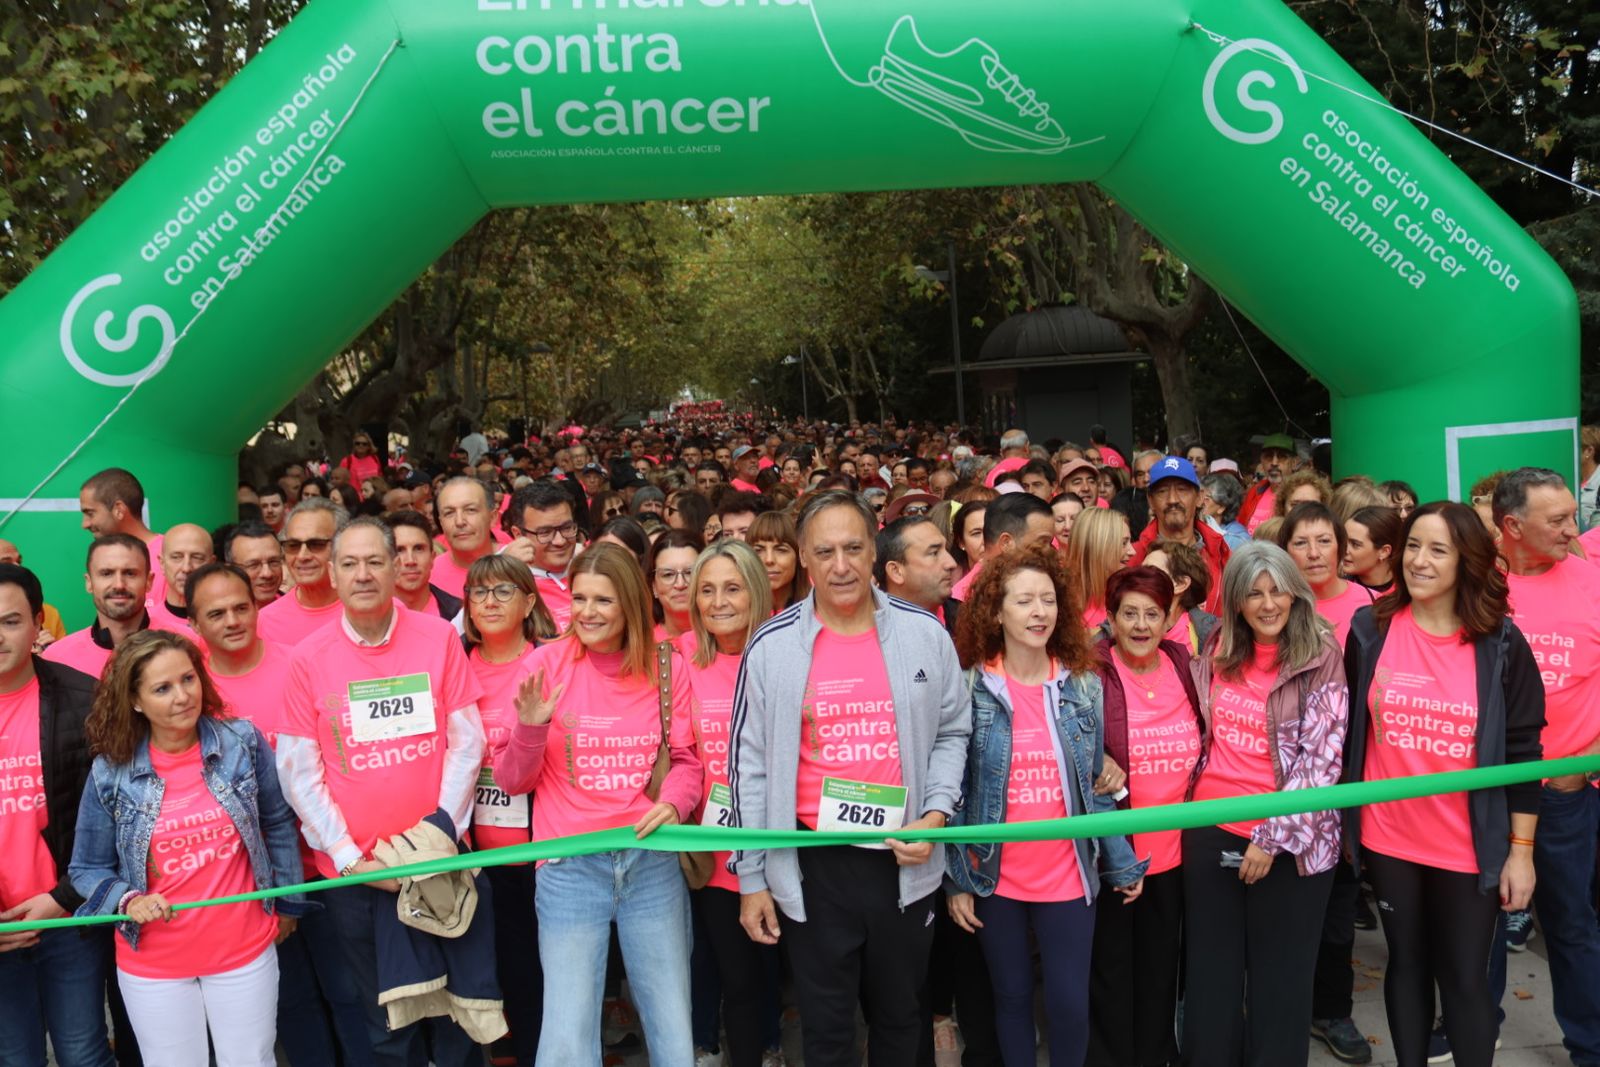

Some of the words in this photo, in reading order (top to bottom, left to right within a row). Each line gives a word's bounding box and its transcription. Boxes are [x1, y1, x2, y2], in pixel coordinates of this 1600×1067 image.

[476, 23, 681, 75] contra
[482, 88, 543, 138] el
[555, 86, 771, 138] cáncer
[141, 142, 256, 263] asociación
[257, 41, 357, 146] española
[490, 145, 556, 158] ASOCIACIÓN
[558, 144, 614, 157] ESPAÑOLA
[616, 146, 661, 156] CONTRA
[663, 146, 676, 154] EL
[678, 143, 721, 154] CÁNCER
[163, 209, 236, 287] contra
[236, 183, 261, 213] el
[259, 108, 338, 189] cáncer
[1302, 132, 1372, 199] contra
[1372, 193, 1399, 220] el
[1394, 209, 1466, 280] cáncer
[1322, 108, 1430, 211] asociación
[1431, 207, 1520, 292] española
[190, 274, 224, 310] en
[219, 153, 347, 281] Salamanca
[1280, 156, 1312, 188] en
[1309, 181, 1428, 289] Salamanca
[1549, 650, 1571, 668] el
[368, 696, 414, 719] 2629
[1220, 688, 1241, 705] En
[1384, 689, 1407, 706] En
[816, 702, 840, 717] En
[701, 719, 722, 733] En
[818, 718, 890, 738] contra
[1144, 720, 1196, 738] marcha
[1383, 711, 1454, 736] contra
[1458, 722, 1478, 737] el
[576, 733, 600, 748] En
[822, 738, 900, 762] cánce
[1386, 728, 1475, 758] cáncer
[350, 735, 438, 771] cáncer
[576, 752, 646, 768] contra
[0, 792, 46, 815] nce
[476, 787, 510, 806] 2725
[154, 816, 178, 834] En
[837, 802, 886, 826] 2626
[156, 823, 234, 853] contra
